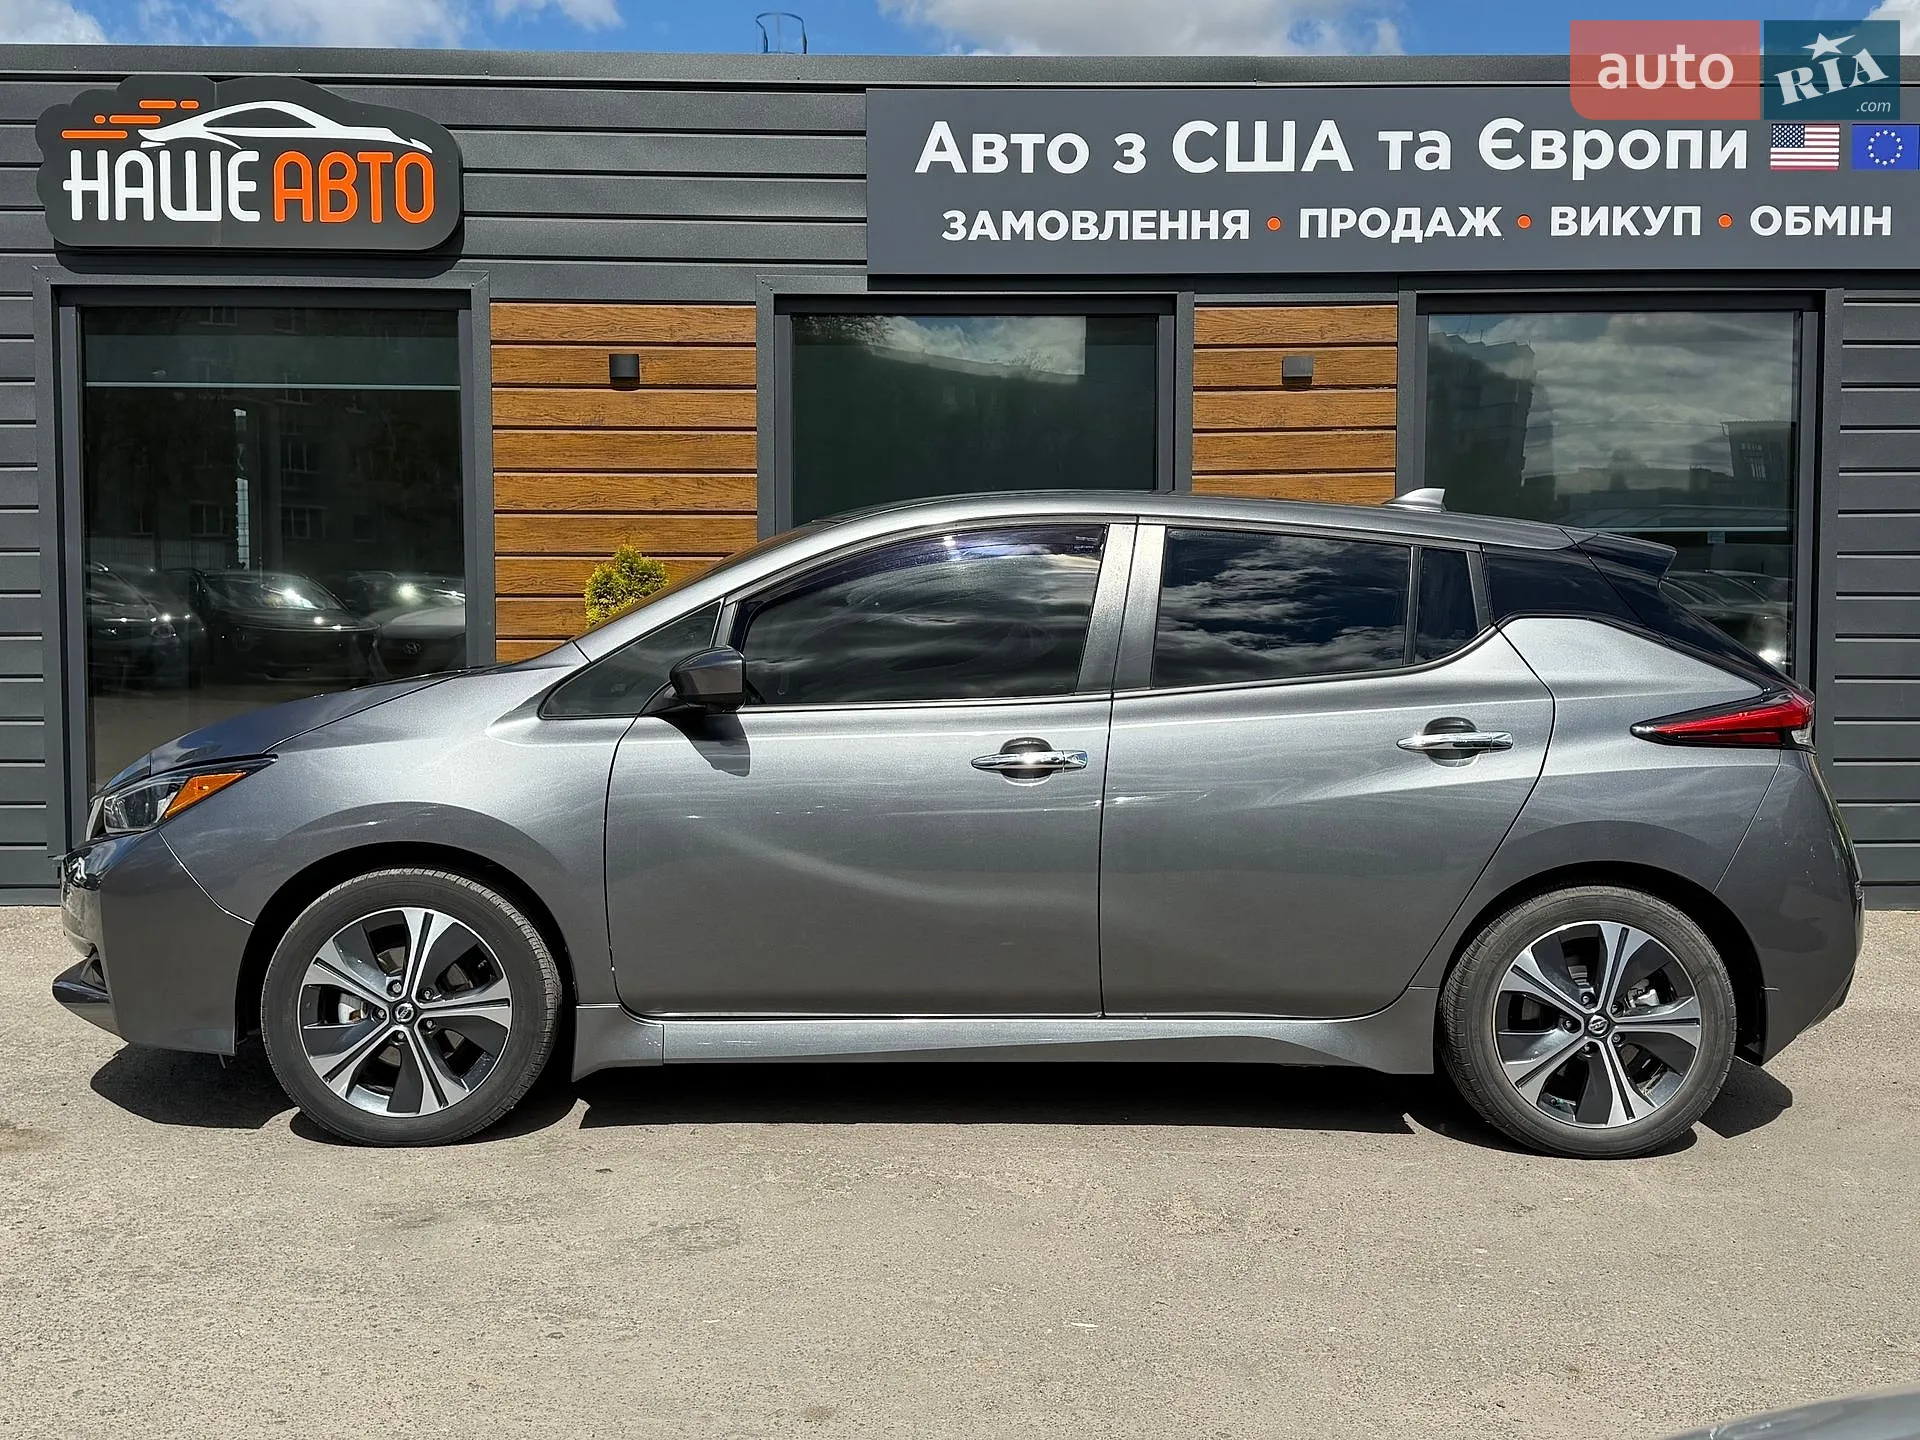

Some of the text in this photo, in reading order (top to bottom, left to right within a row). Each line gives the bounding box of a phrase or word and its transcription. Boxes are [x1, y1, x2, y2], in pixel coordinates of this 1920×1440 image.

[914, 117, 1748, 180] Авто з США та Європи
[62, 149, 435, 224] НАШЕ АВТО
[941, 205, 1892, 243] ЗАМОВЛЕННЯ ПРОДАЖ ВИКУП ОБМІН
